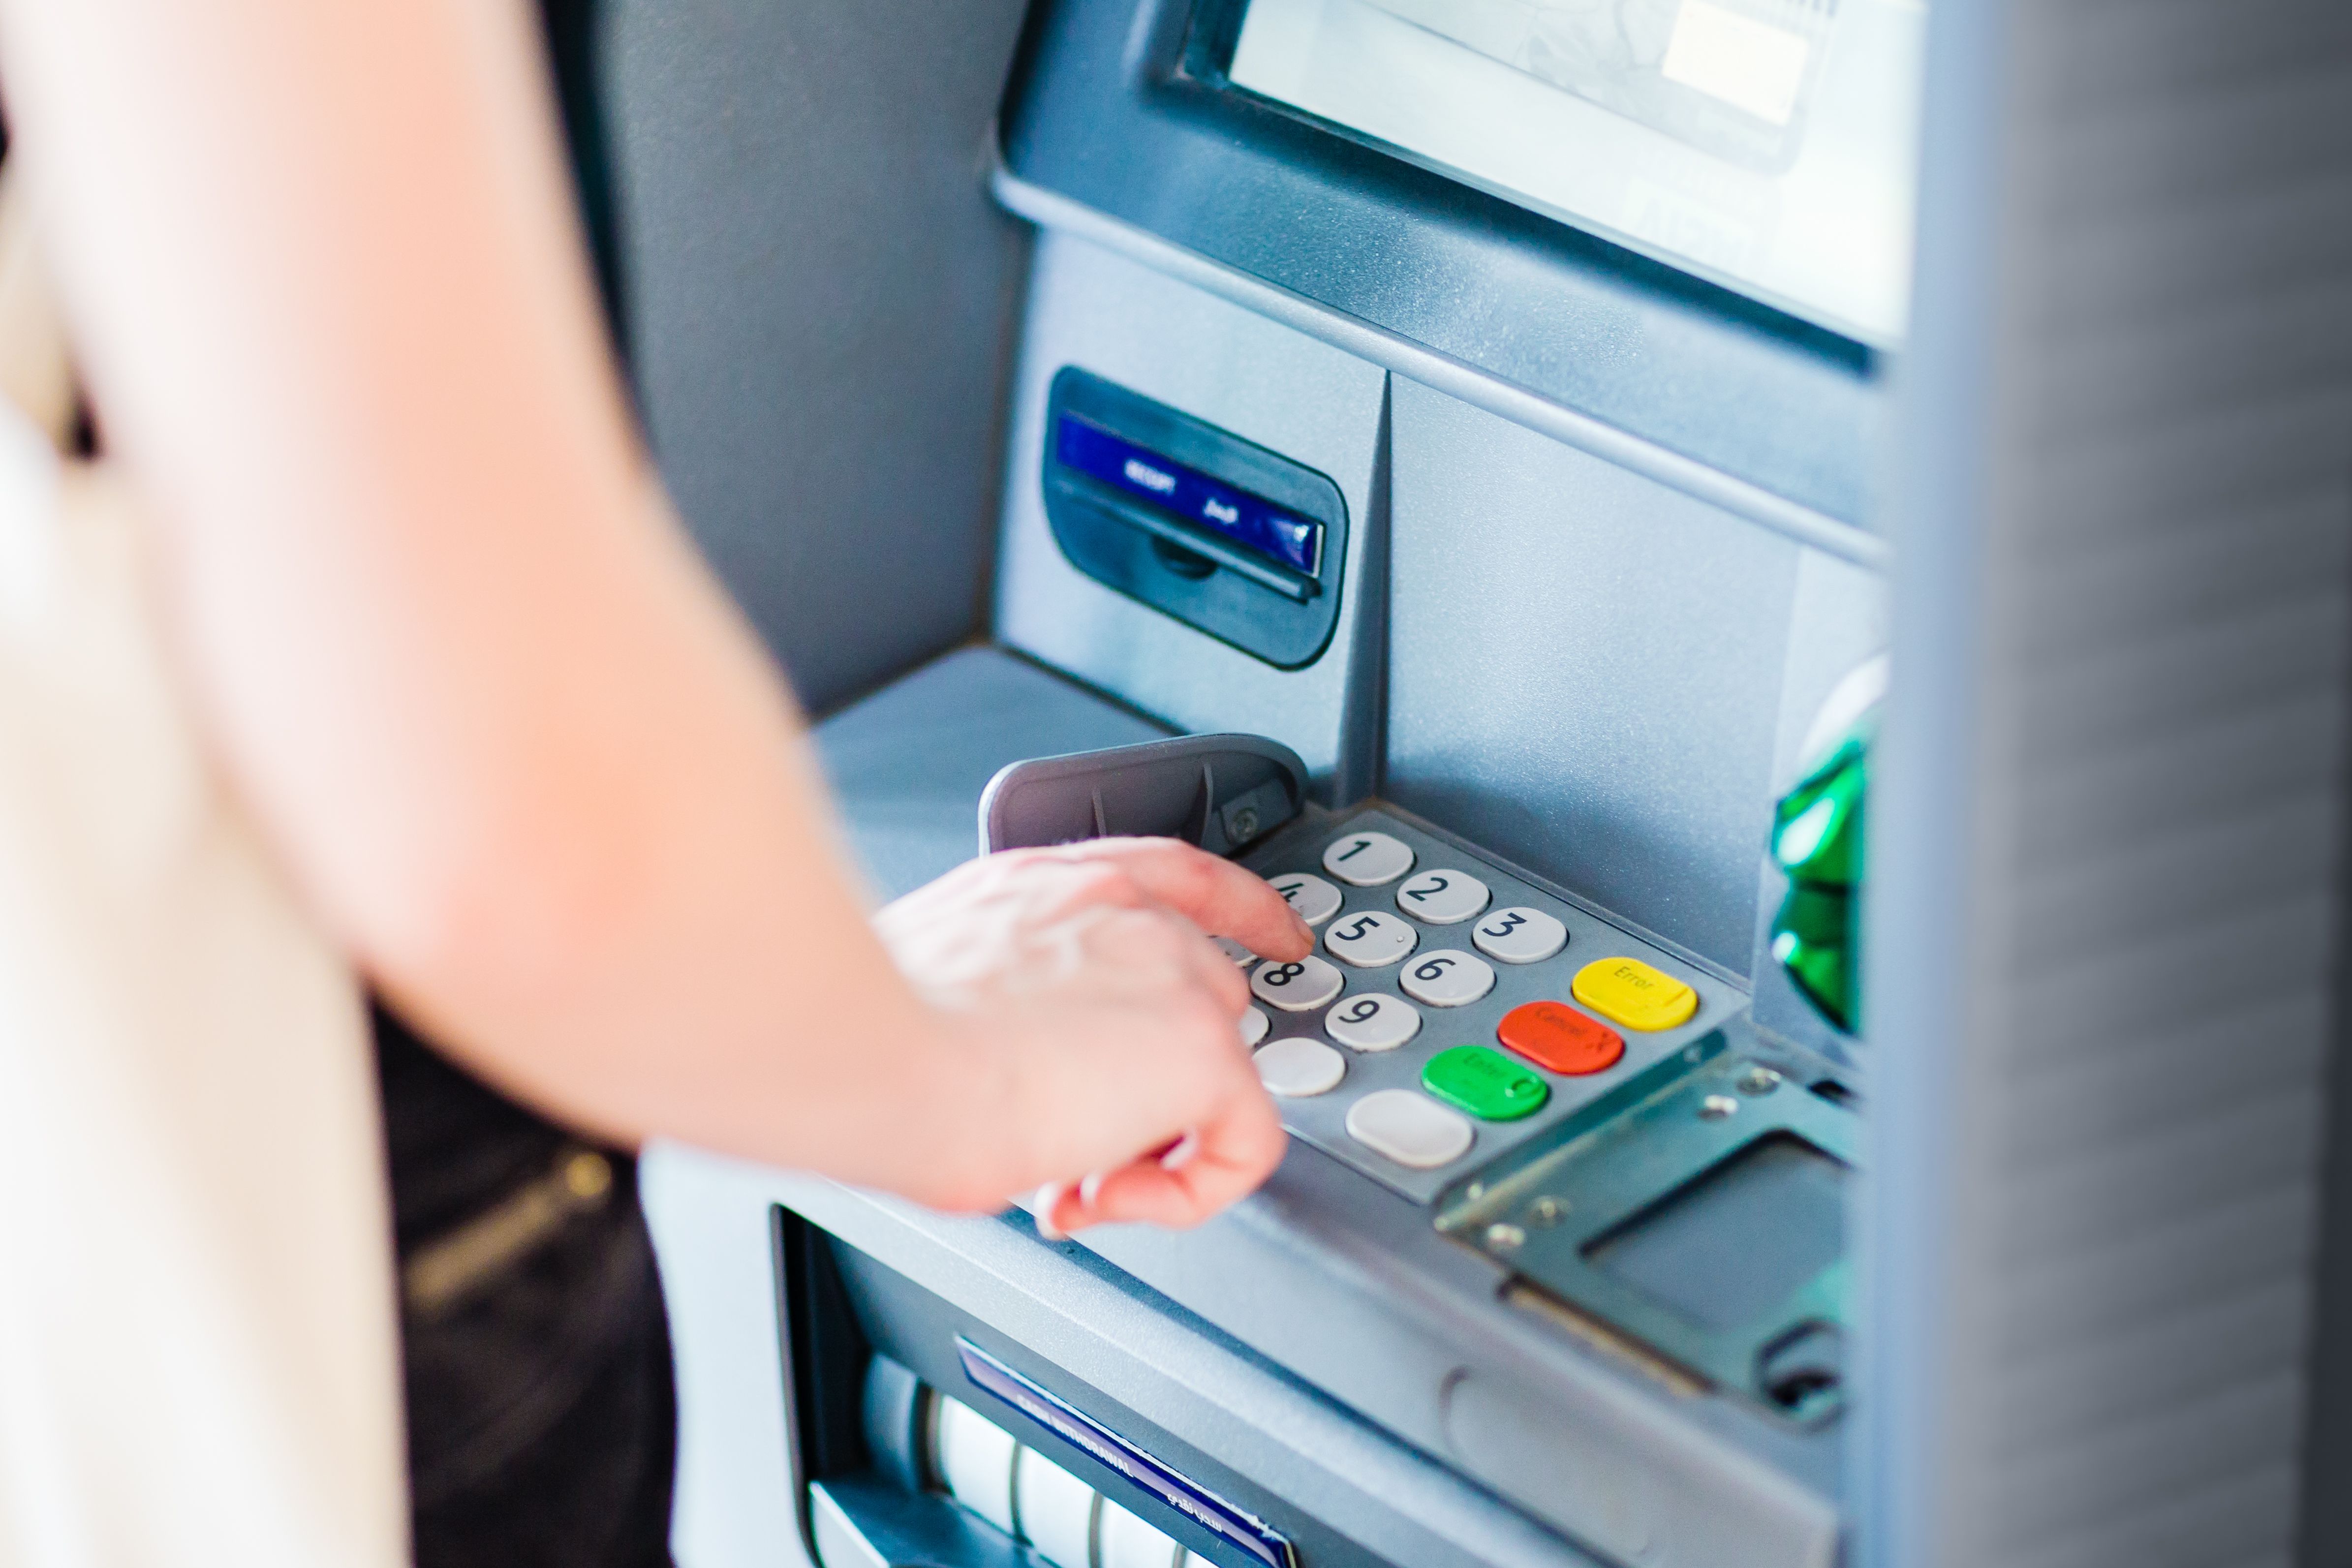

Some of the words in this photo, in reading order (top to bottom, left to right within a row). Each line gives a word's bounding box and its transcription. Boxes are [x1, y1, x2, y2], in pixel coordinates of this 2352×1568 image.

[1338, 840, 1371, 861] 1
[1406, 877, 1448, 901] 2
[1335, 916, 1380, 941] 5
[1482, 912, 1527, 937] 3
[1263, 962, 1305, 986] 8
[1415, 958, 1456, 981] 6
[1614, 966, 1654, 989] Error
[1338, 1000, 1380, 1023] 9
[1050, 1415, 1134, 1477] WITHDRAWAL
